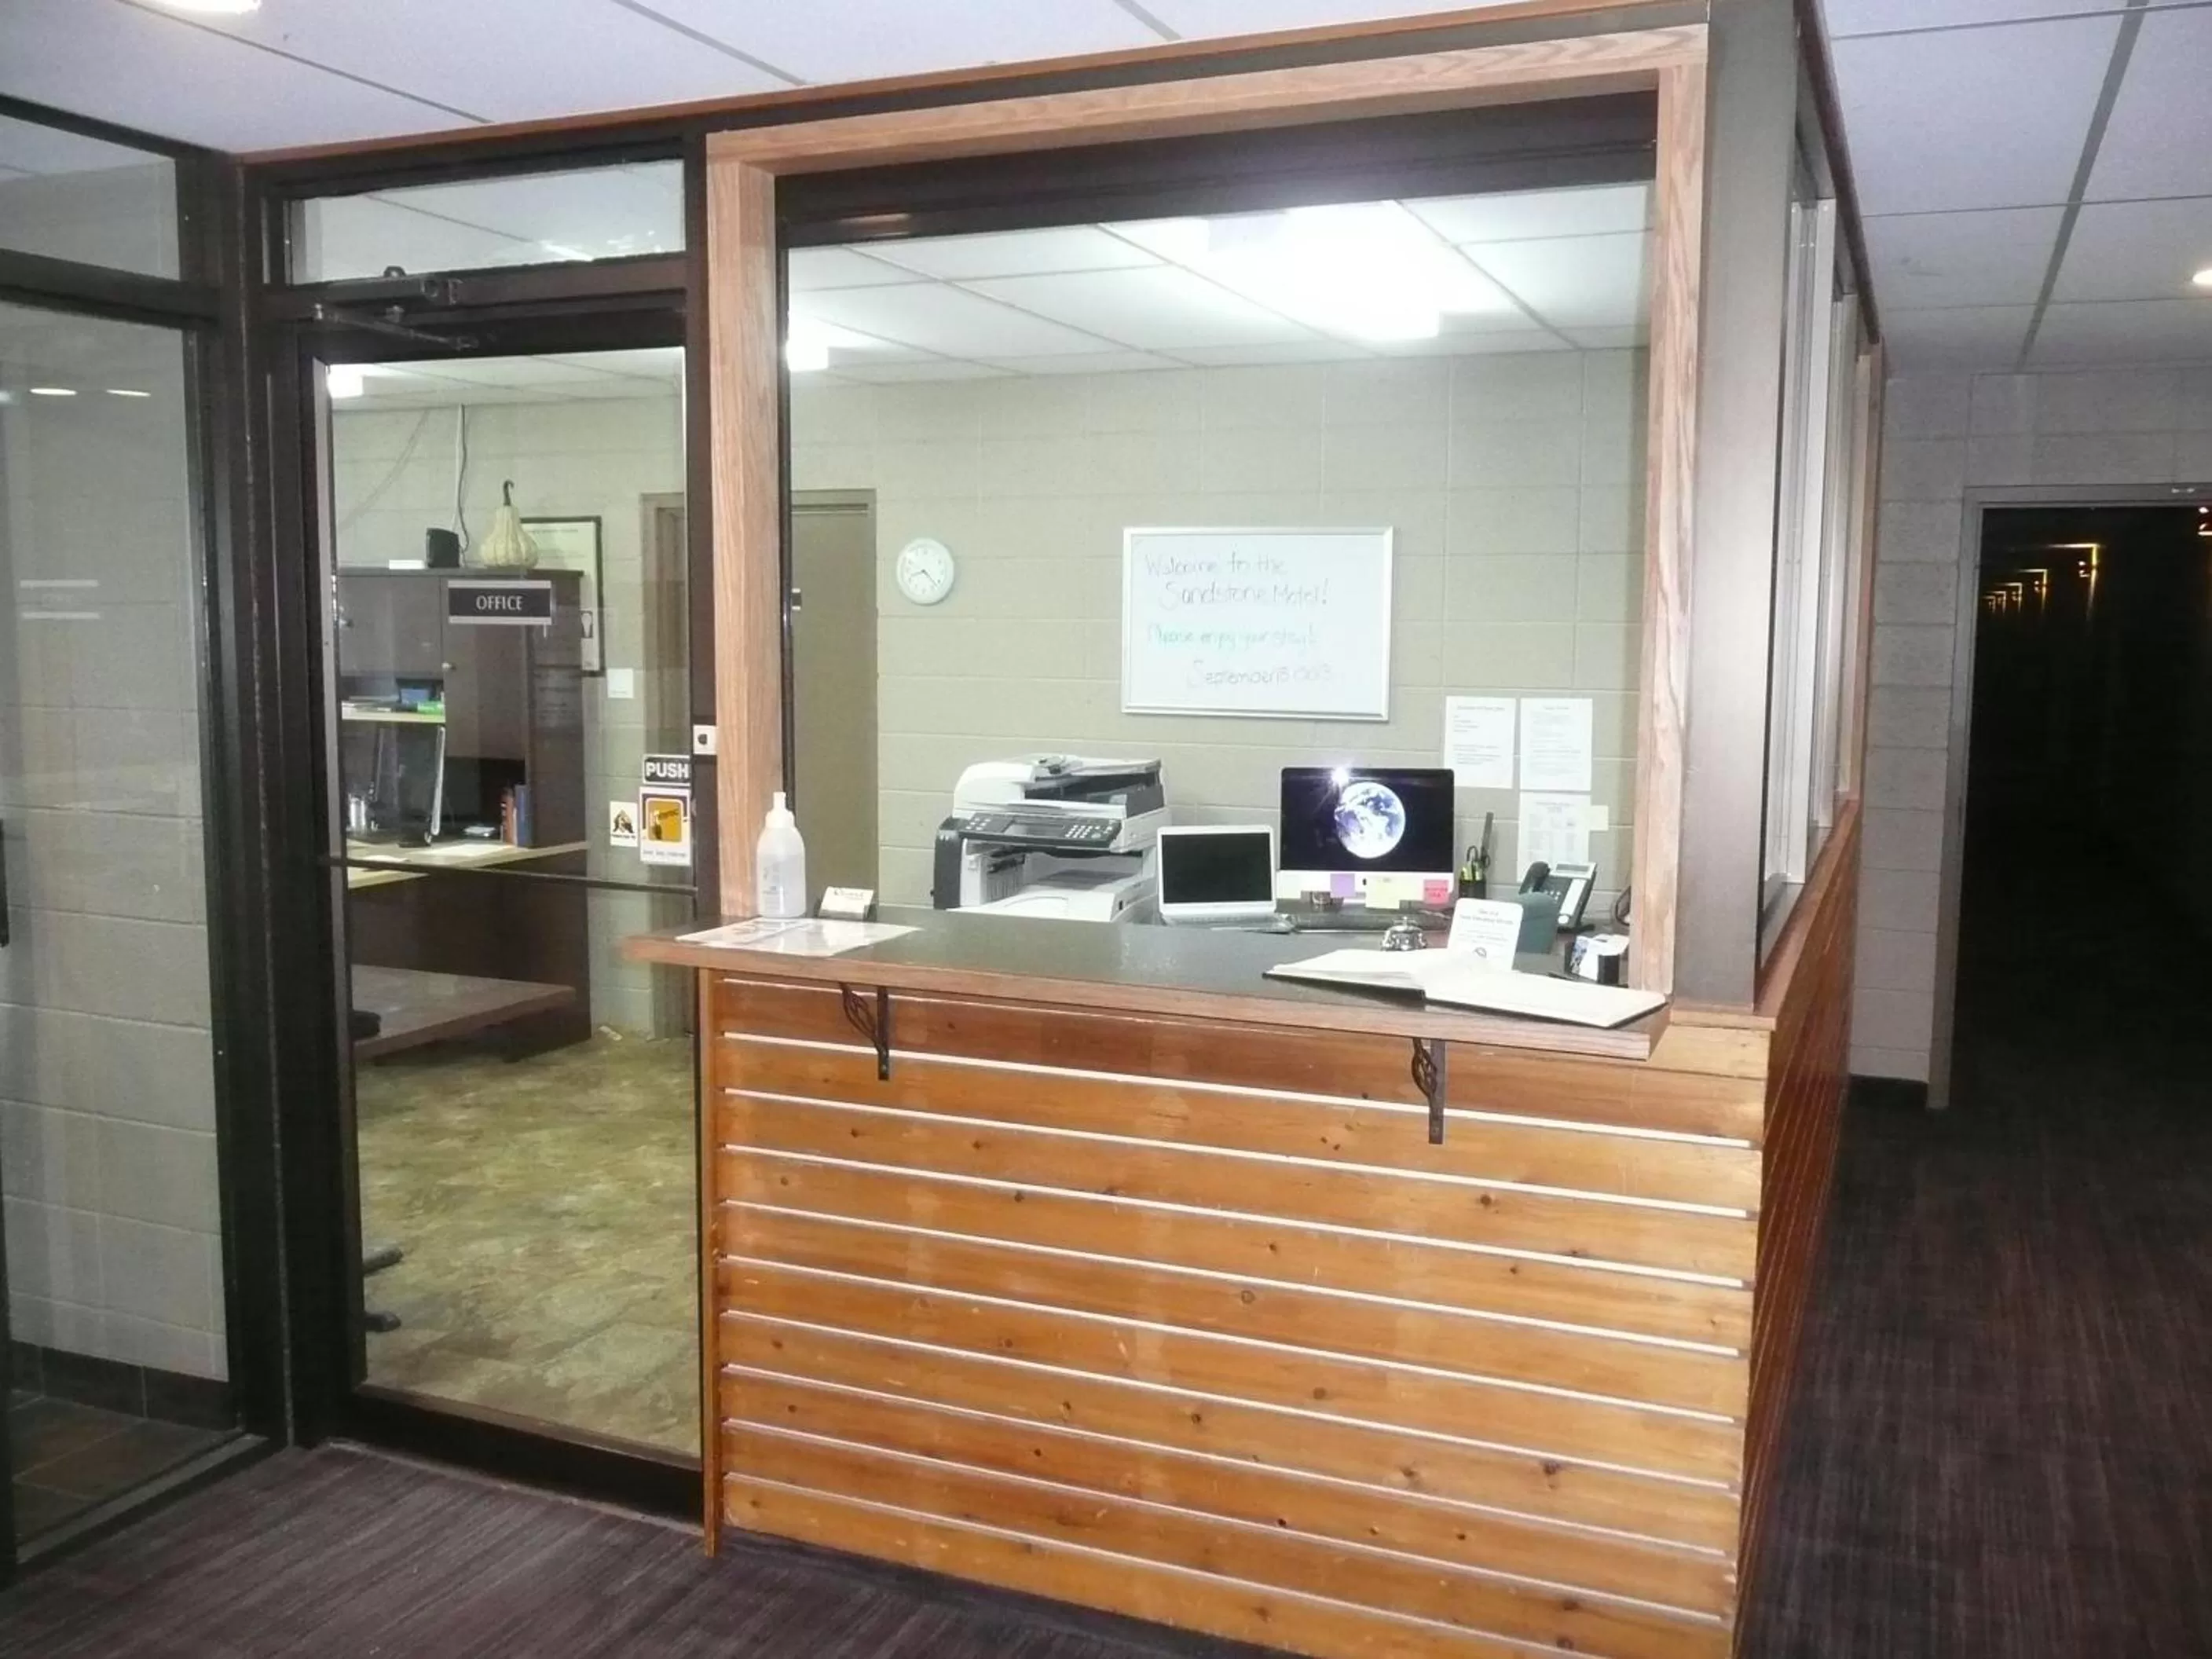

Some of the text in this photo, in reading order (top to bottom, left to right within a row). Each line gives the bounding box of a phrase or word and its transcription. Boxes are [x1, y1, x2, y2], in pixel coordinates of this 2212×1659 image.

[1144, 550, 1287, 577] Welcome to the
[476, 595, 523, 610] OFFICE
[1158, 580, 1267, 610] Sandstone
[645, 762, 690, 779] PUSH
